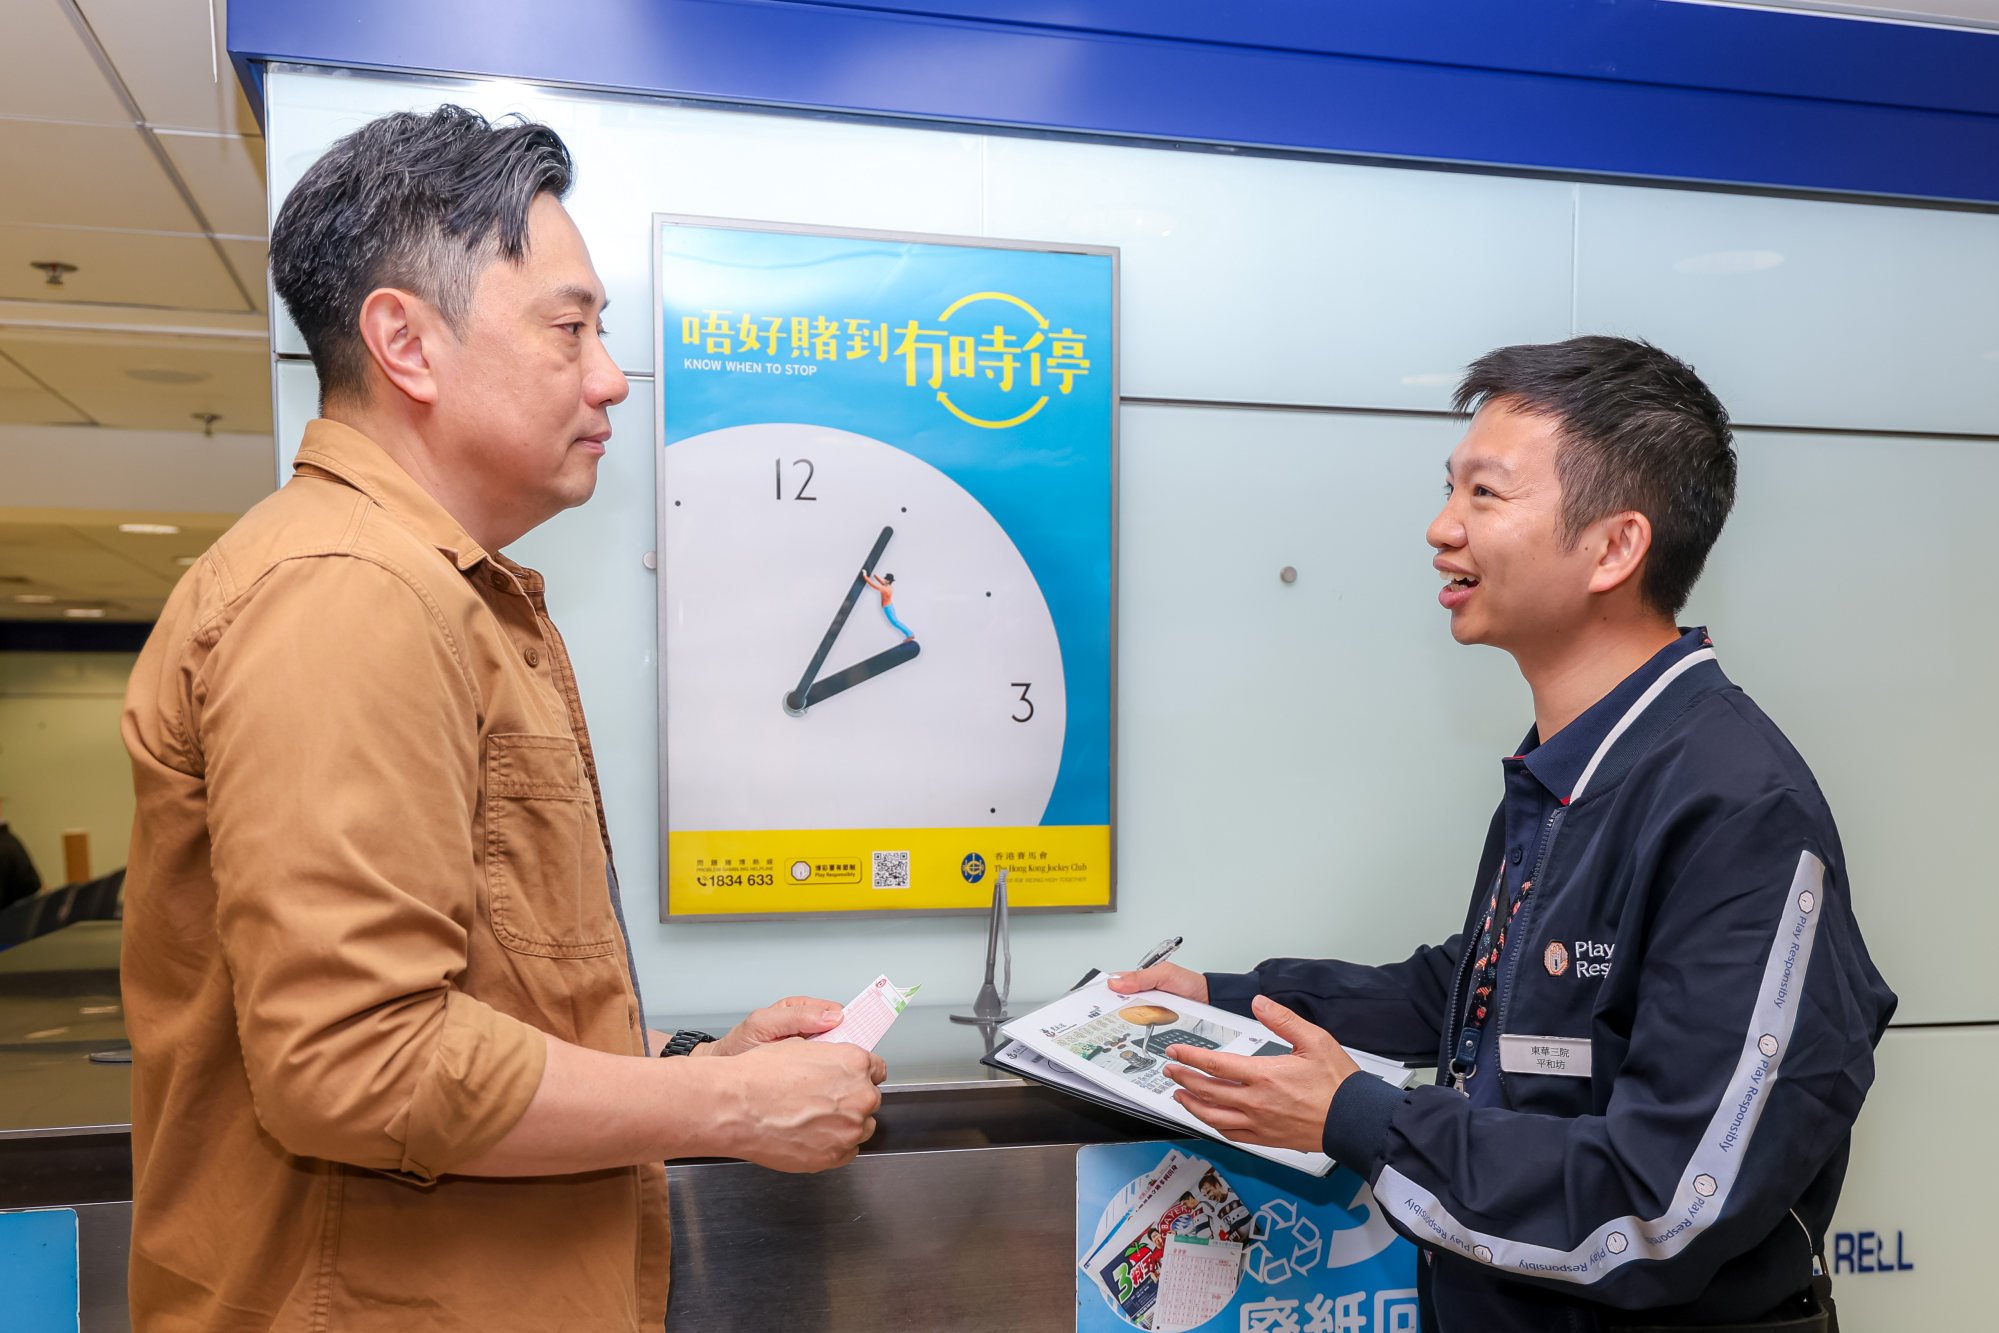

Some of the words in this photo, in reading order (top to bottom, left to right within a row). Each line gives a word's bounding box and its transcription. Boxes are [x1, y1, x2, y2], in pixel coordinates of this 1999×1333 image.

[684, 358, 722, 371] KNOW
[725, 360, 762, 373] WHEN
[765, 363, 782, 374] TO
[785, 364, 817, 376] STOP
[776, 458, 817, 500] 12
[1010, 682, 1034, 723] 3
[995, 852, 1048, 860] 香港賽馬會
[1008, 864, 1027, 873] Hong
[1028, 864, 1046, 873] Kong
[1047, 863, 1069, 873] Jockey
[1070, 862, 1087, 871] Club
[709, 874, 742, 887] 1834
[747, 873, 774, 886] 633
[1792, 916, 1808, 940] Play
[1575, 940, 1615, 958] Play
[1774, 942, 1800, 1008] Responsibly
[1531, 1046, 1570, 1058] 東華三院
[1536, 1059, 1566, 1070] 平和坊
[1751, 1060, 1769, 1084] Play
[1721, 1087, 1758, 1152] Responsibly
[1688, 1196, 1705, 1218] Play
[1404, 1198, 1447, 1240] Responsibly
[1450, 1234, 1470, 1251] Play
[1519, 1259, 1588, 1272] Responsibly
[1589, 1248, 1606, 1265] Play
